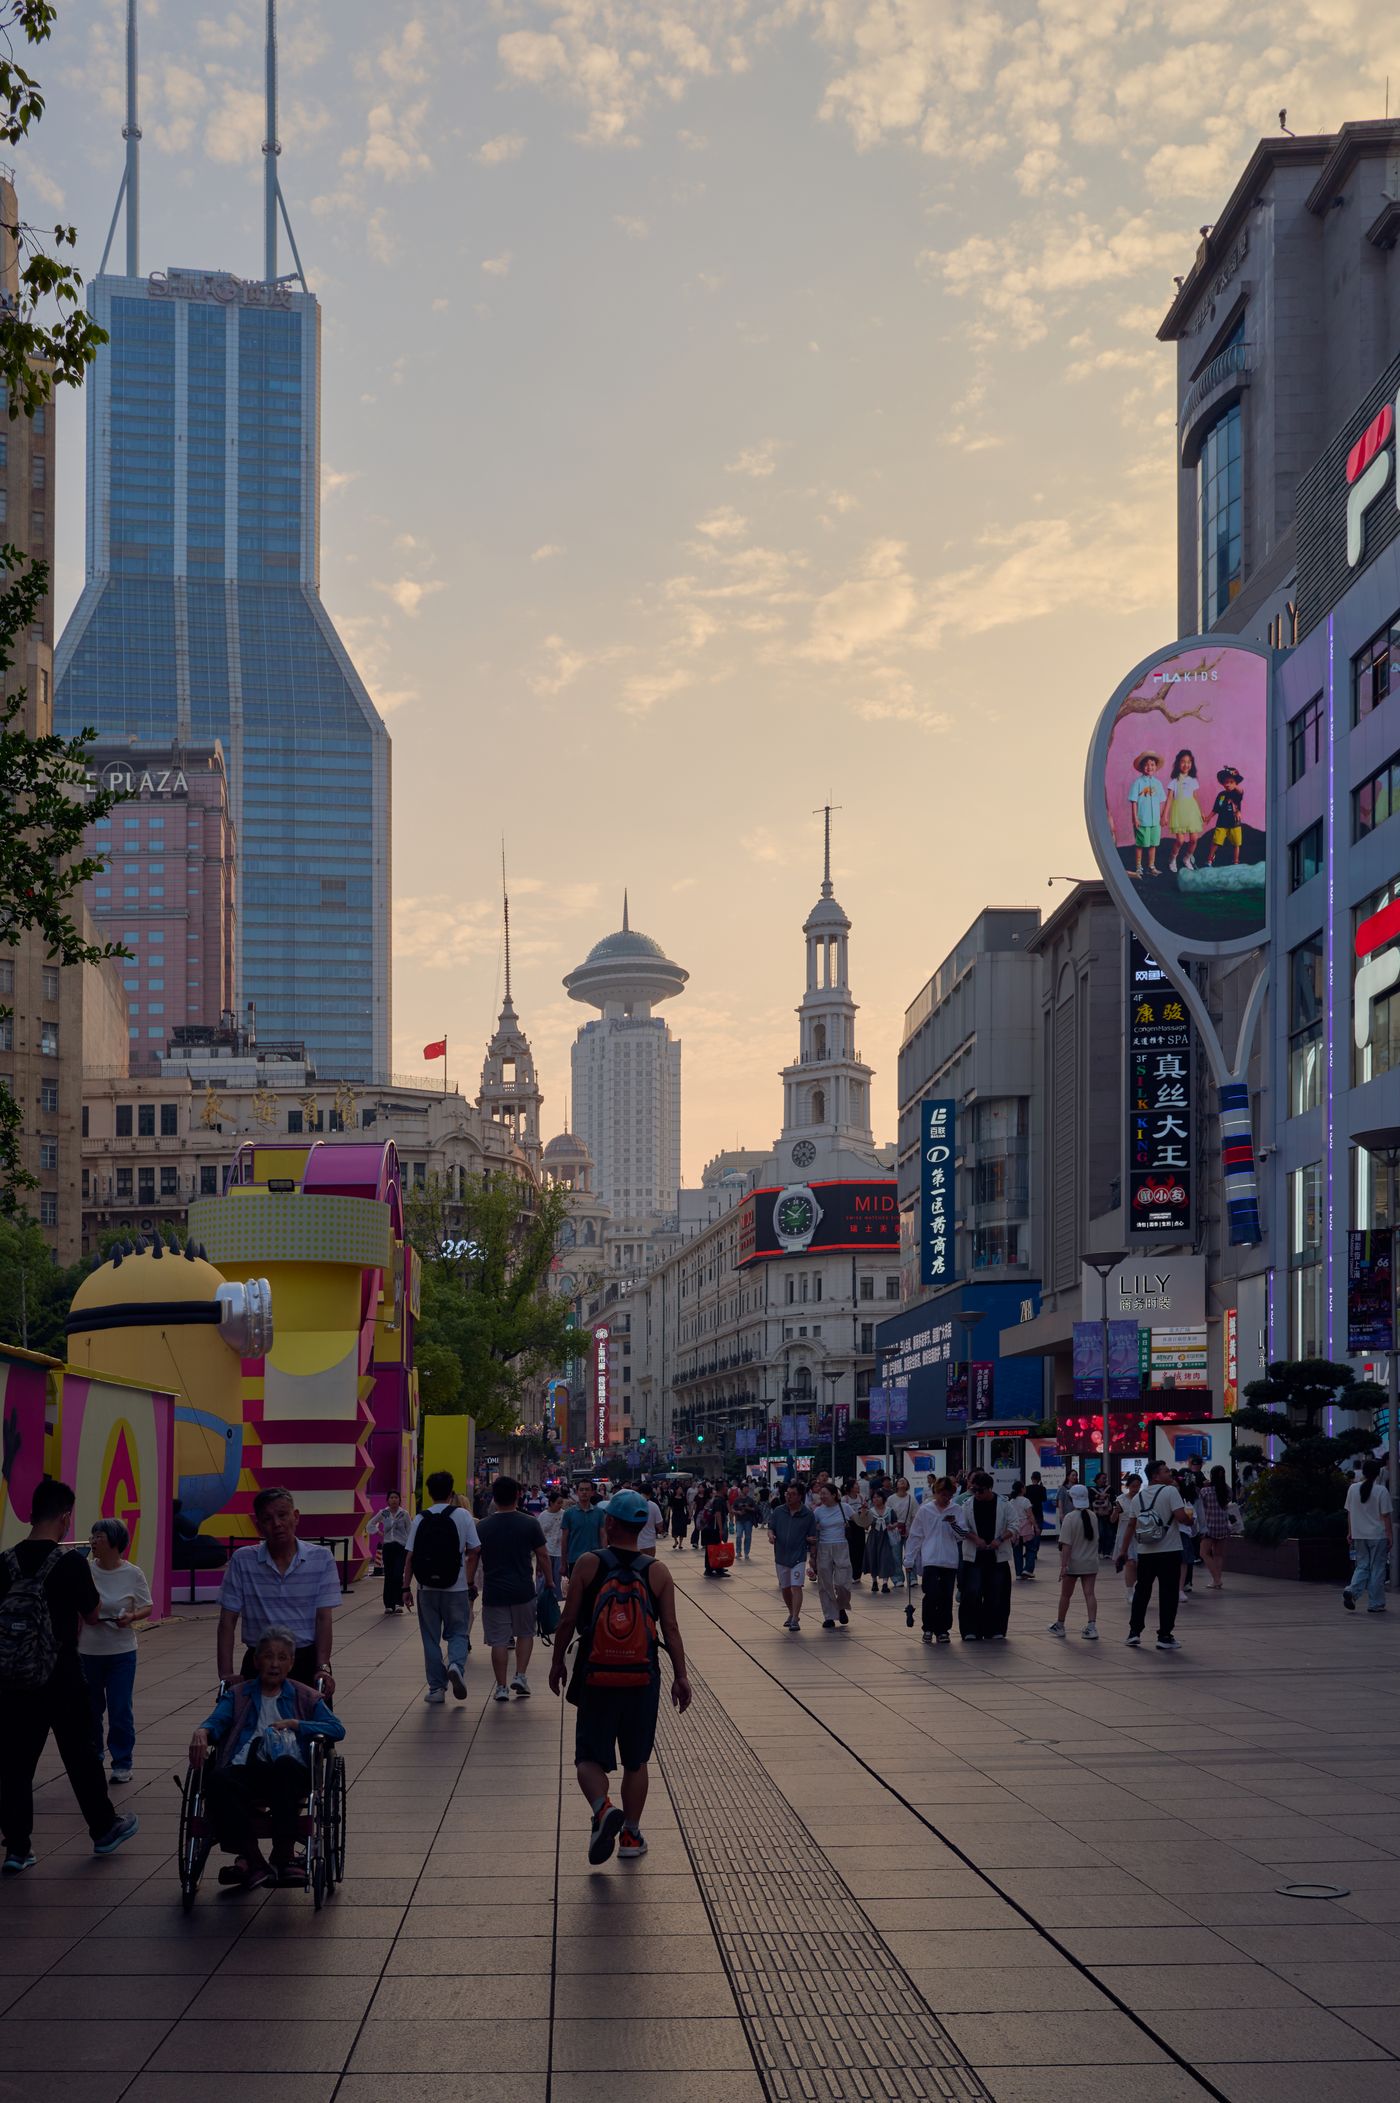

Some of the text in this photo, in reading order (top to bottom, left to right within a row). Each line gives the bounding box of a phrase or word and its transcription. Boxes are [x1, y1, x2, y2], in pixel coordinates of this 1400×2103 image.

[1153, 671, 1219, 683] FILA KIDS
[110, 771, 189, 793] PLAZA
[1133, 994, 1143, 1002] 4F
[1168, 1034, 1189, 1046] SPA
[1136, 1055, 1147, 1064] 3F
[855, 1195, 898, 1213] MID
[929, 1167, 947, 1275] 第一医药商店
[1120, 1274, 1171, 1294] LILY
[1120, 1296, 1171, 1311] 商务时装
